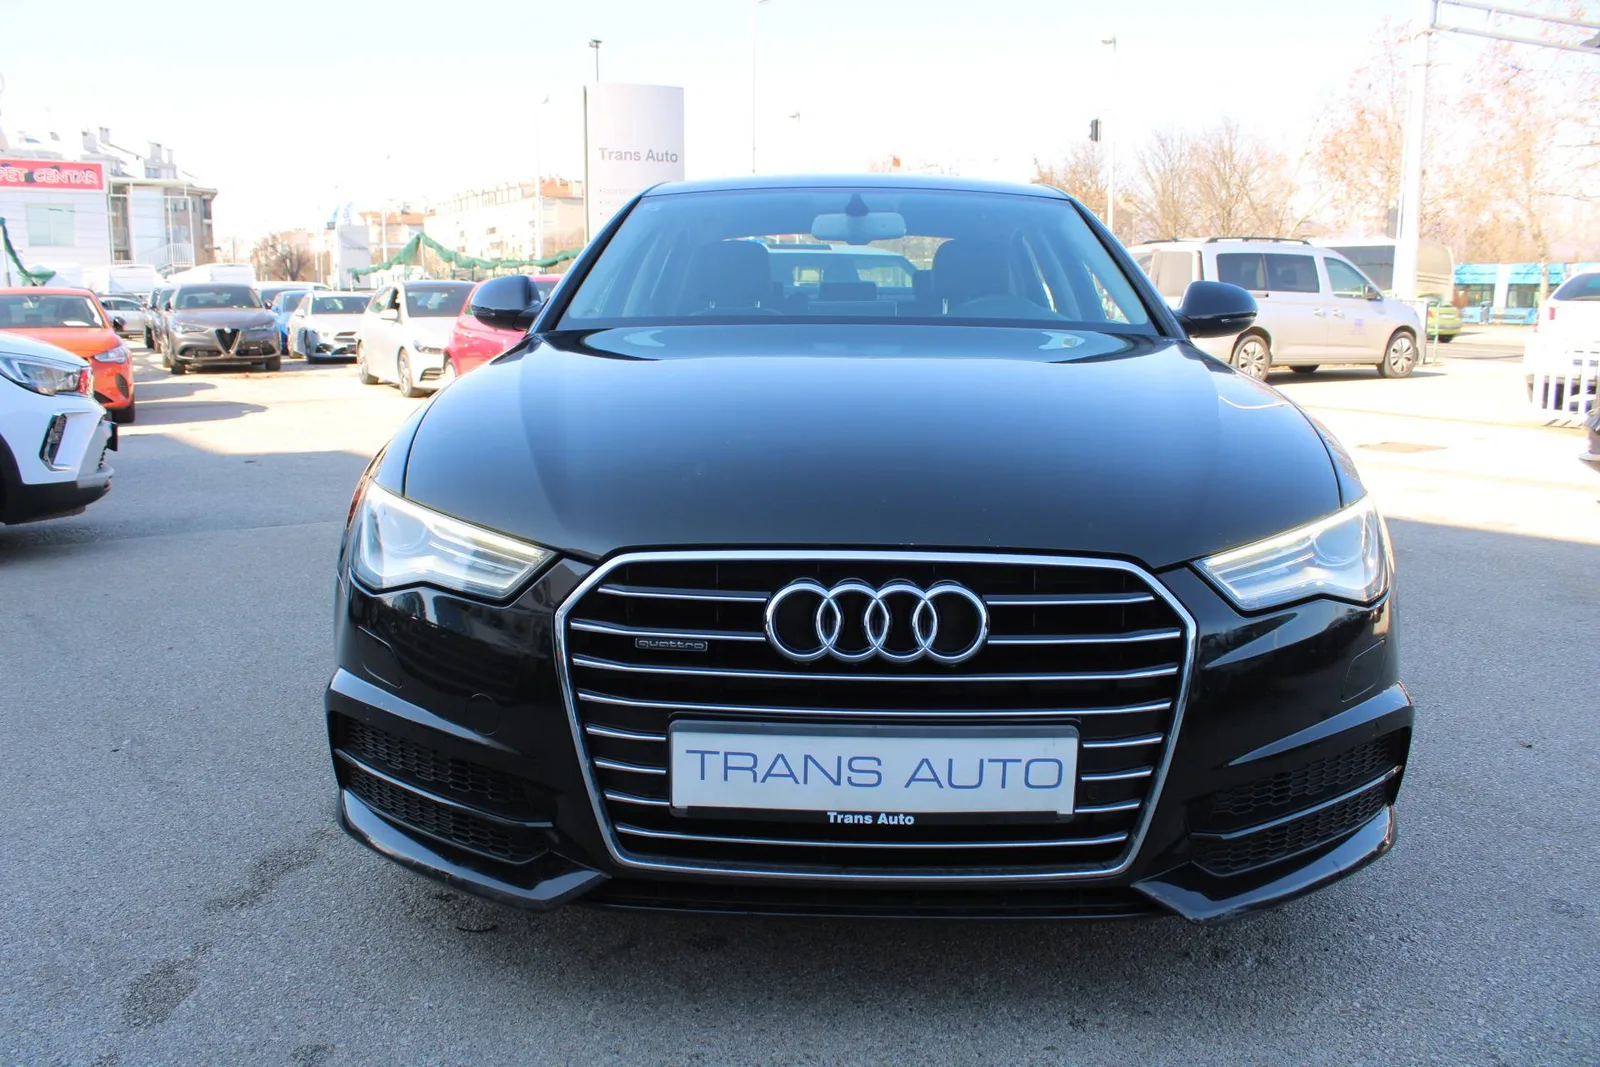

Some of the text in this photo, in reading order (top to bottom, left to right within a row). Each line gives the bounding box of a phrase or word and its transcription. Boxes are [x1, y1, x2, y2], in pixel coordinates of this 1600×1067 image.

[598, 147, 678, 163] Trans Auto
[33, 168, 98, 185] CENTAR
[638, 640, 704, 649] quattro
[685, 749, 1064, 790] TRANS AUTO
[827, 811, 915, 826] Trans Auto
